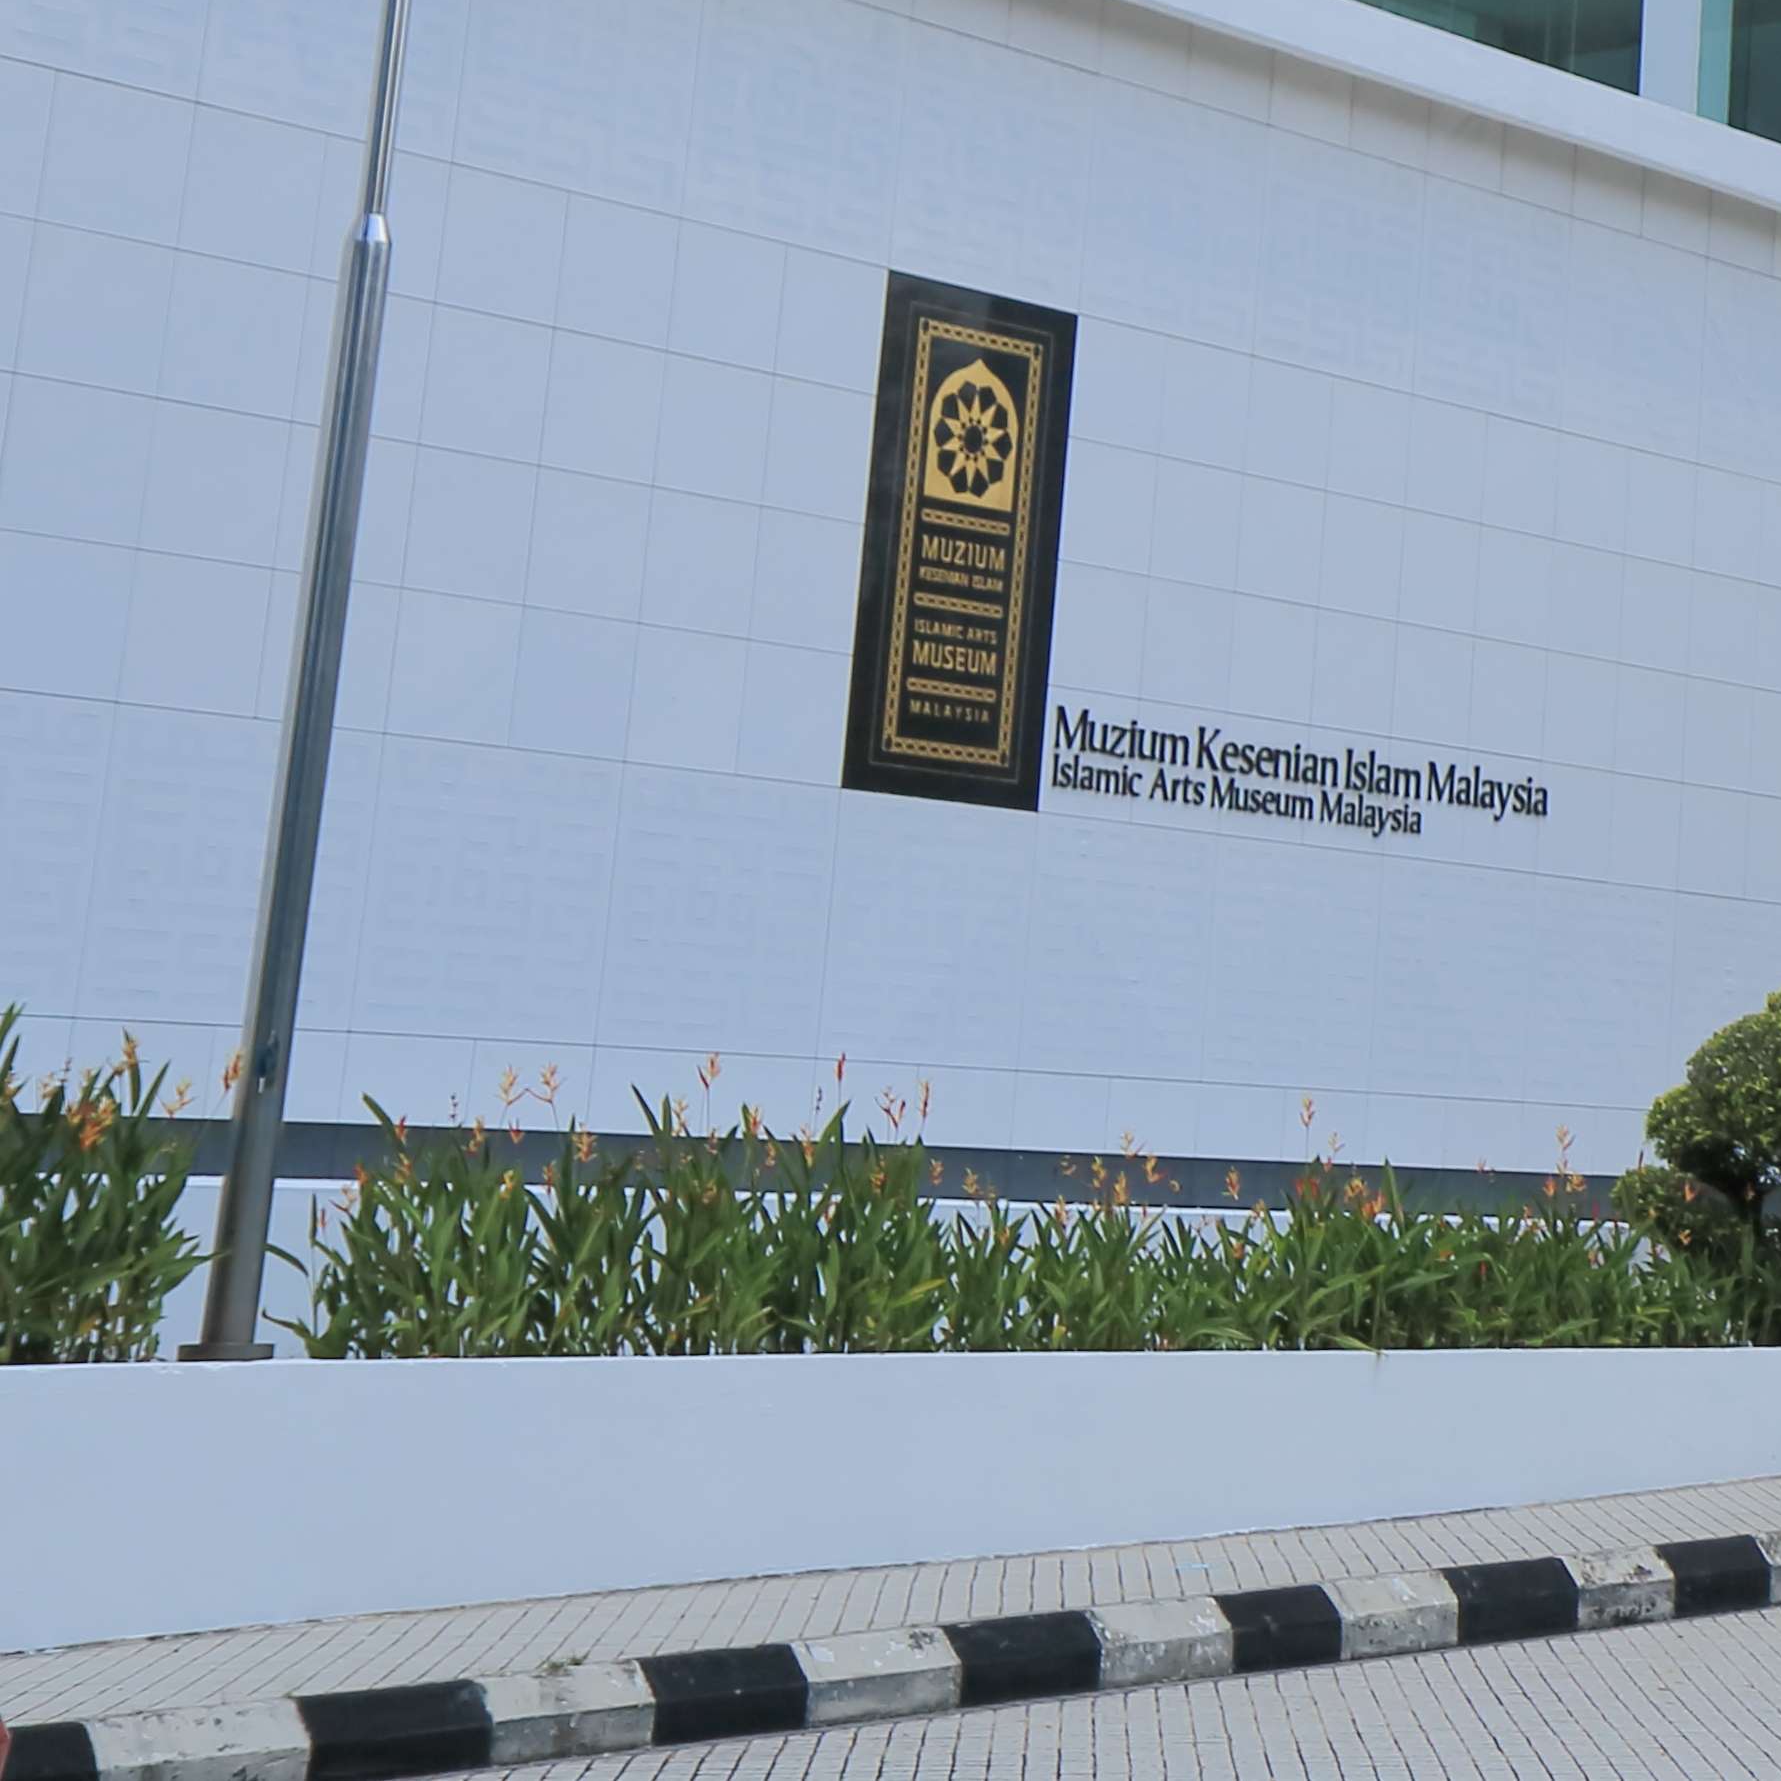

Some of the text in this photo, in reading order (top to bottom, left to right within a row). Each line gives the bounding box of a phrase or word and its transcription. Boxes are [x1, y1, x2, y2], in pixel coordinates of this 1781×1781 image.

[922, 534, 1005, 570] MUZIUM
[914, 618, 997, 645] ISLAMIC ARTS
[912, 639, 997, 676] MUSEUM
[909, 699, 990, 723] MALAYSIA
[1054, 705, 1548, 821] Muzium Kesenian Islam Malaysia
[1051, 753, 1423, 837] Islamic Arts Museum Malaysia
